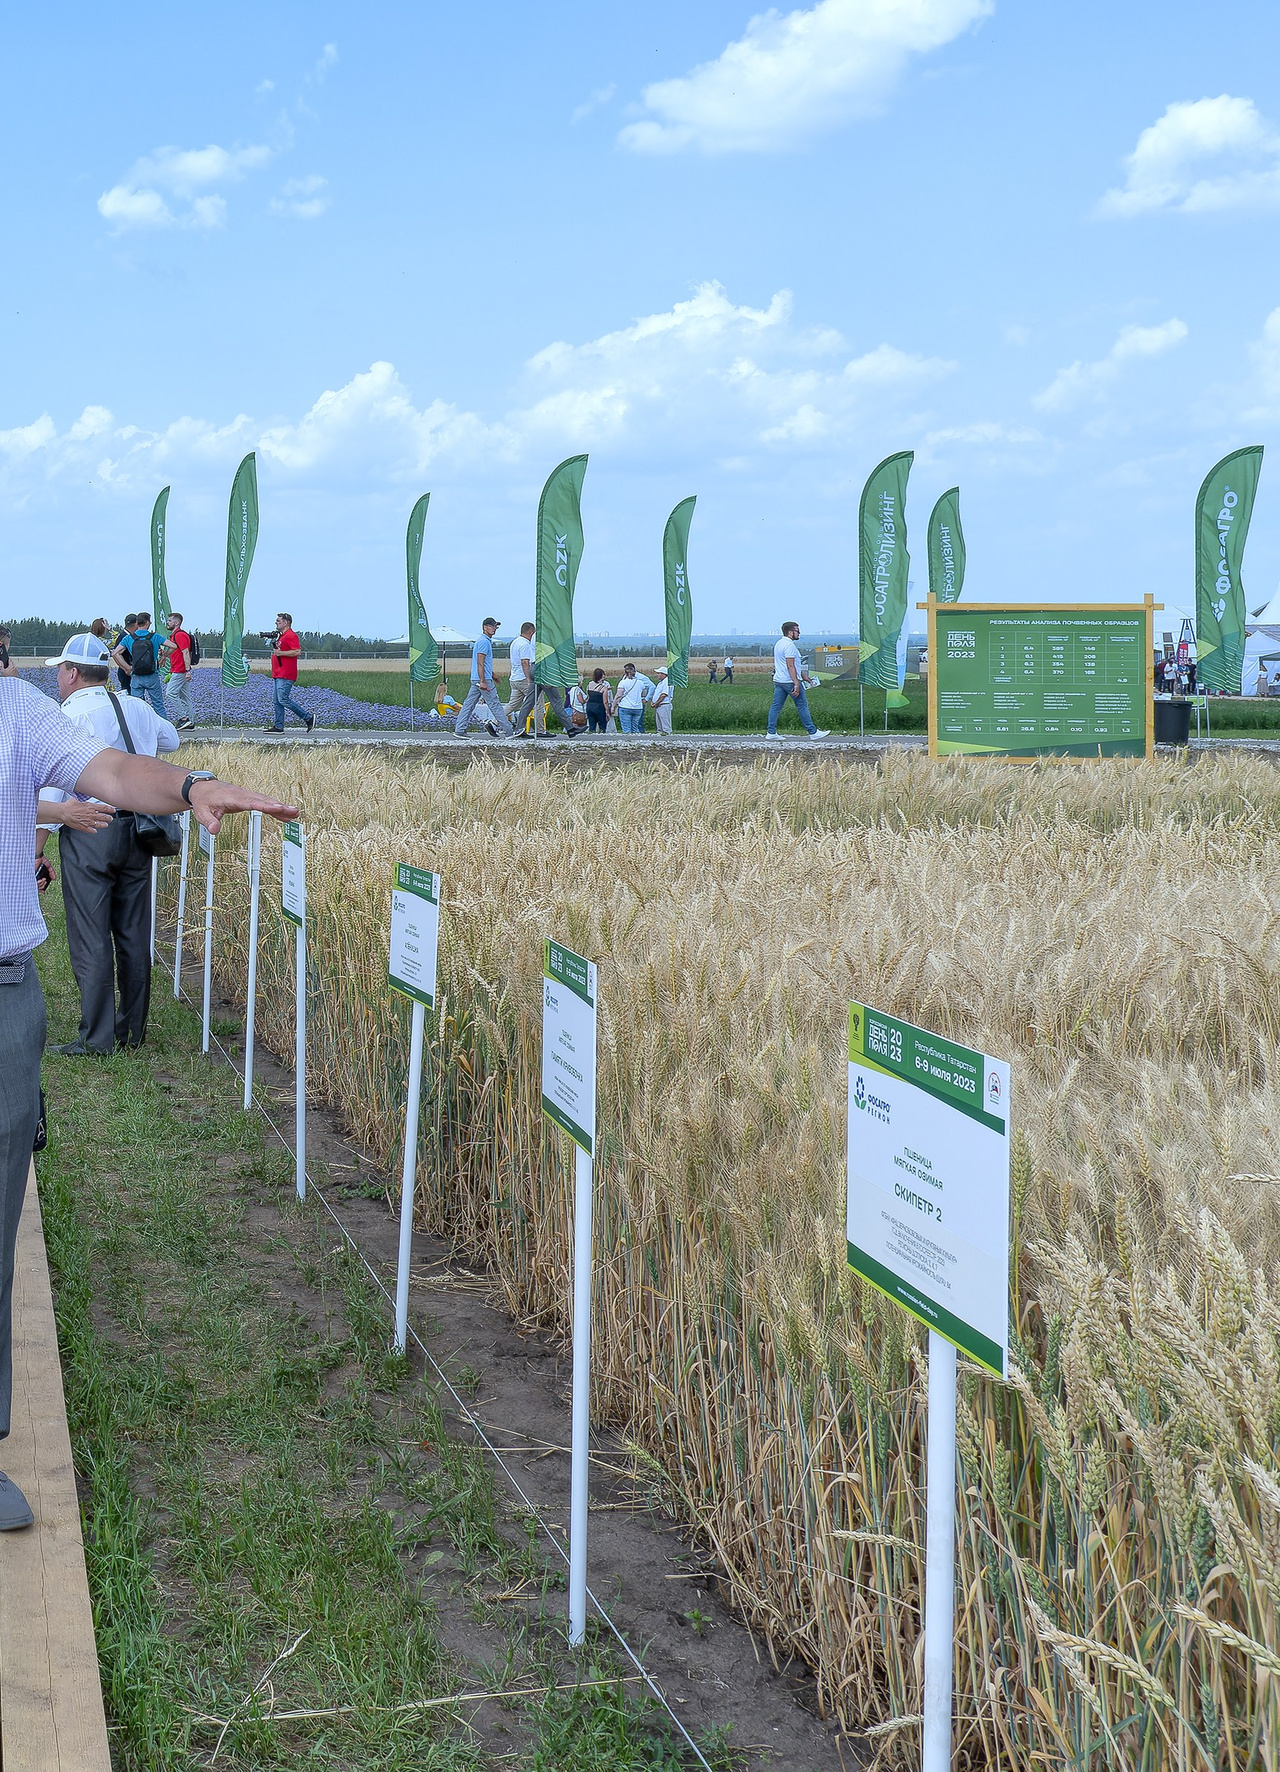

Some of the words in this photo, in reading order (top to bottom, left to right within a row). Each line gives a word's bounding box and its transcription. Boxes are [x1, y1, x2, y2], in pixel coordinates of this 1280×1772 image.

[947, 633, 976, 641] ДЕНЬ
[947, 640, 976, 648] ПОЛЯ
[947, 651, 976, 659] 2023
[869, 1024, 888, 1042] ДЕНЬ
[890, 1028, 902, 1045] 20
[868, 1038, 887, 1056] ПОЛЯ
[890, 1045, 902, 1062] 23
[914, 1040, 946, 1061] Республика
[946, 1053, 977, 1074] Татарстан
[915, 1056, 929, 1072] 6-9
[930, 1064, 951, 1083] июля
[953, 1073, 976, 1094] 2023
[867, 1106, 891, 1125] РЕГИОН
[904, 1147, 933, 1170] ПШЕНИЦА
[894, 1155, 917, 1175] МЯГКАЯ
[917, 1169, 943, 1191] ОЗИМАЯ
[894, 1182, 934, 1216] СКИПЕТР
[936, 1207, 942, 1222] 2
